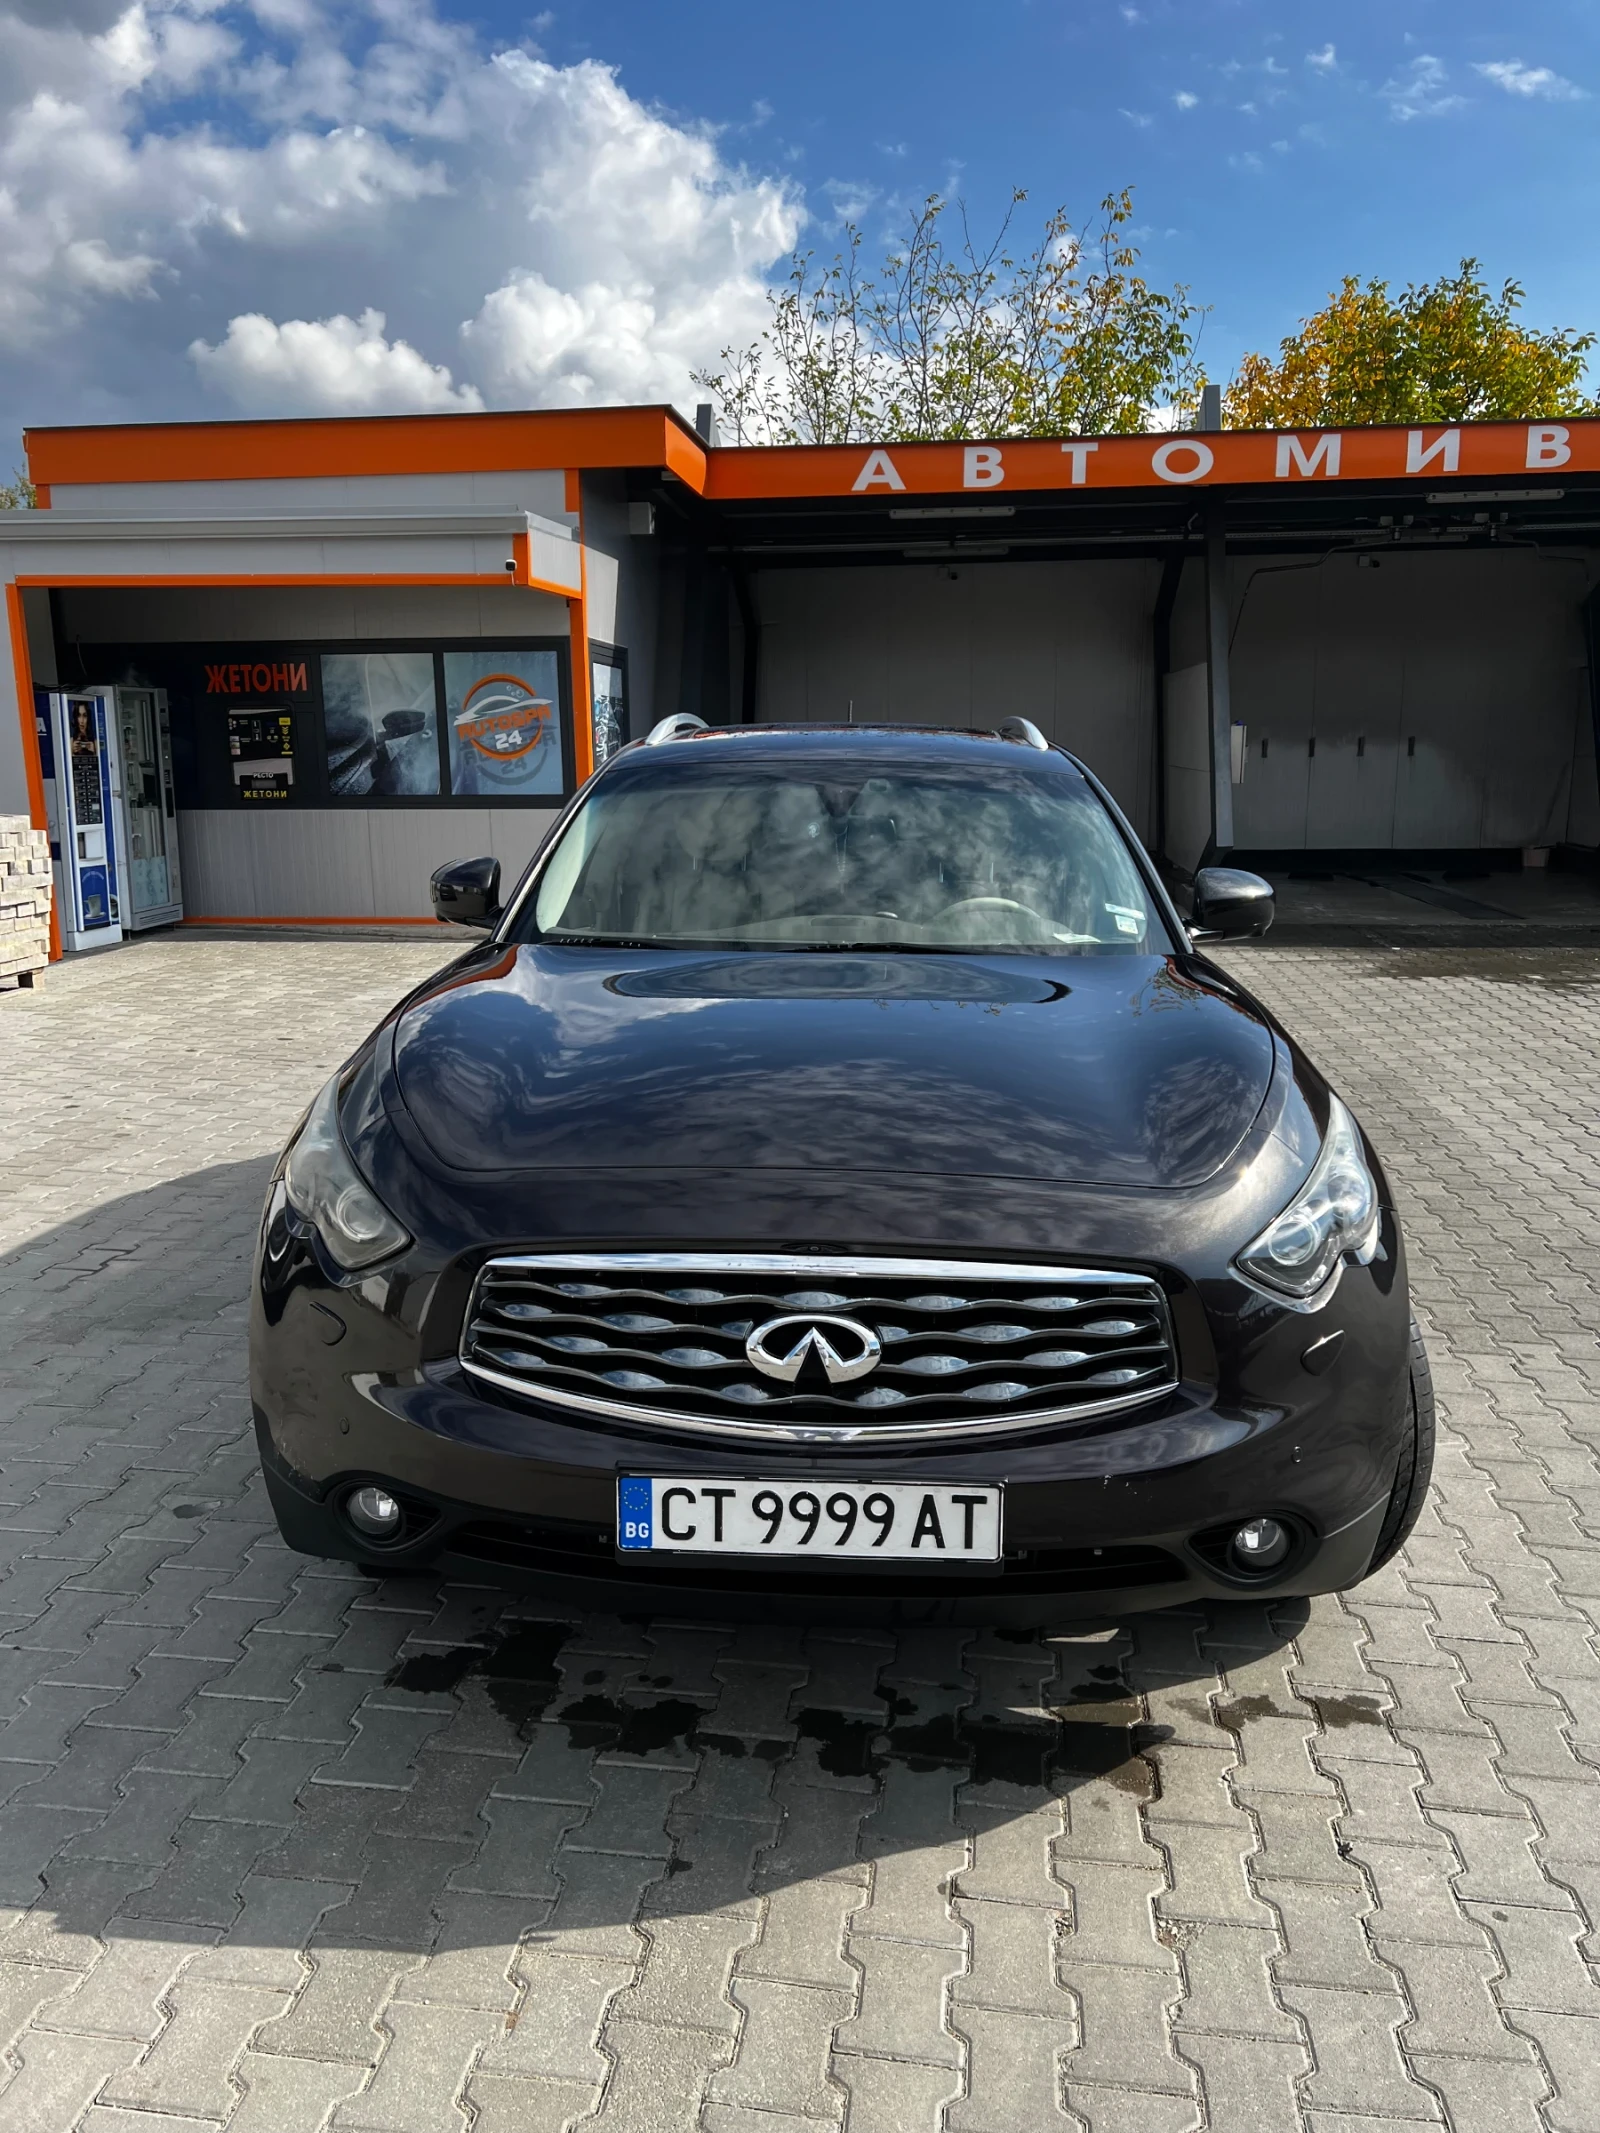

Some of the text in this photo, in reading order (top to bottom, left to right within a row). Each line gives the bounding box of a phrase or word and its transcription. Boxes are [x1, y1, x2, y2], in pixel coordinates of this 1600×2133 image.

[851, 425, 1571, 491] АВТОМИВ
[204, 663, 307, 693] ЖЕТОНИ
[457, 705, 552, 740] AUTOSPA
[495, 730, 523, 750] 24
[243, 790, 287, 798] ЖЕТОНИ
[625, 1522, 650, 1539] BG
[661, 1487, 988, 1549] CT 9999 AT
